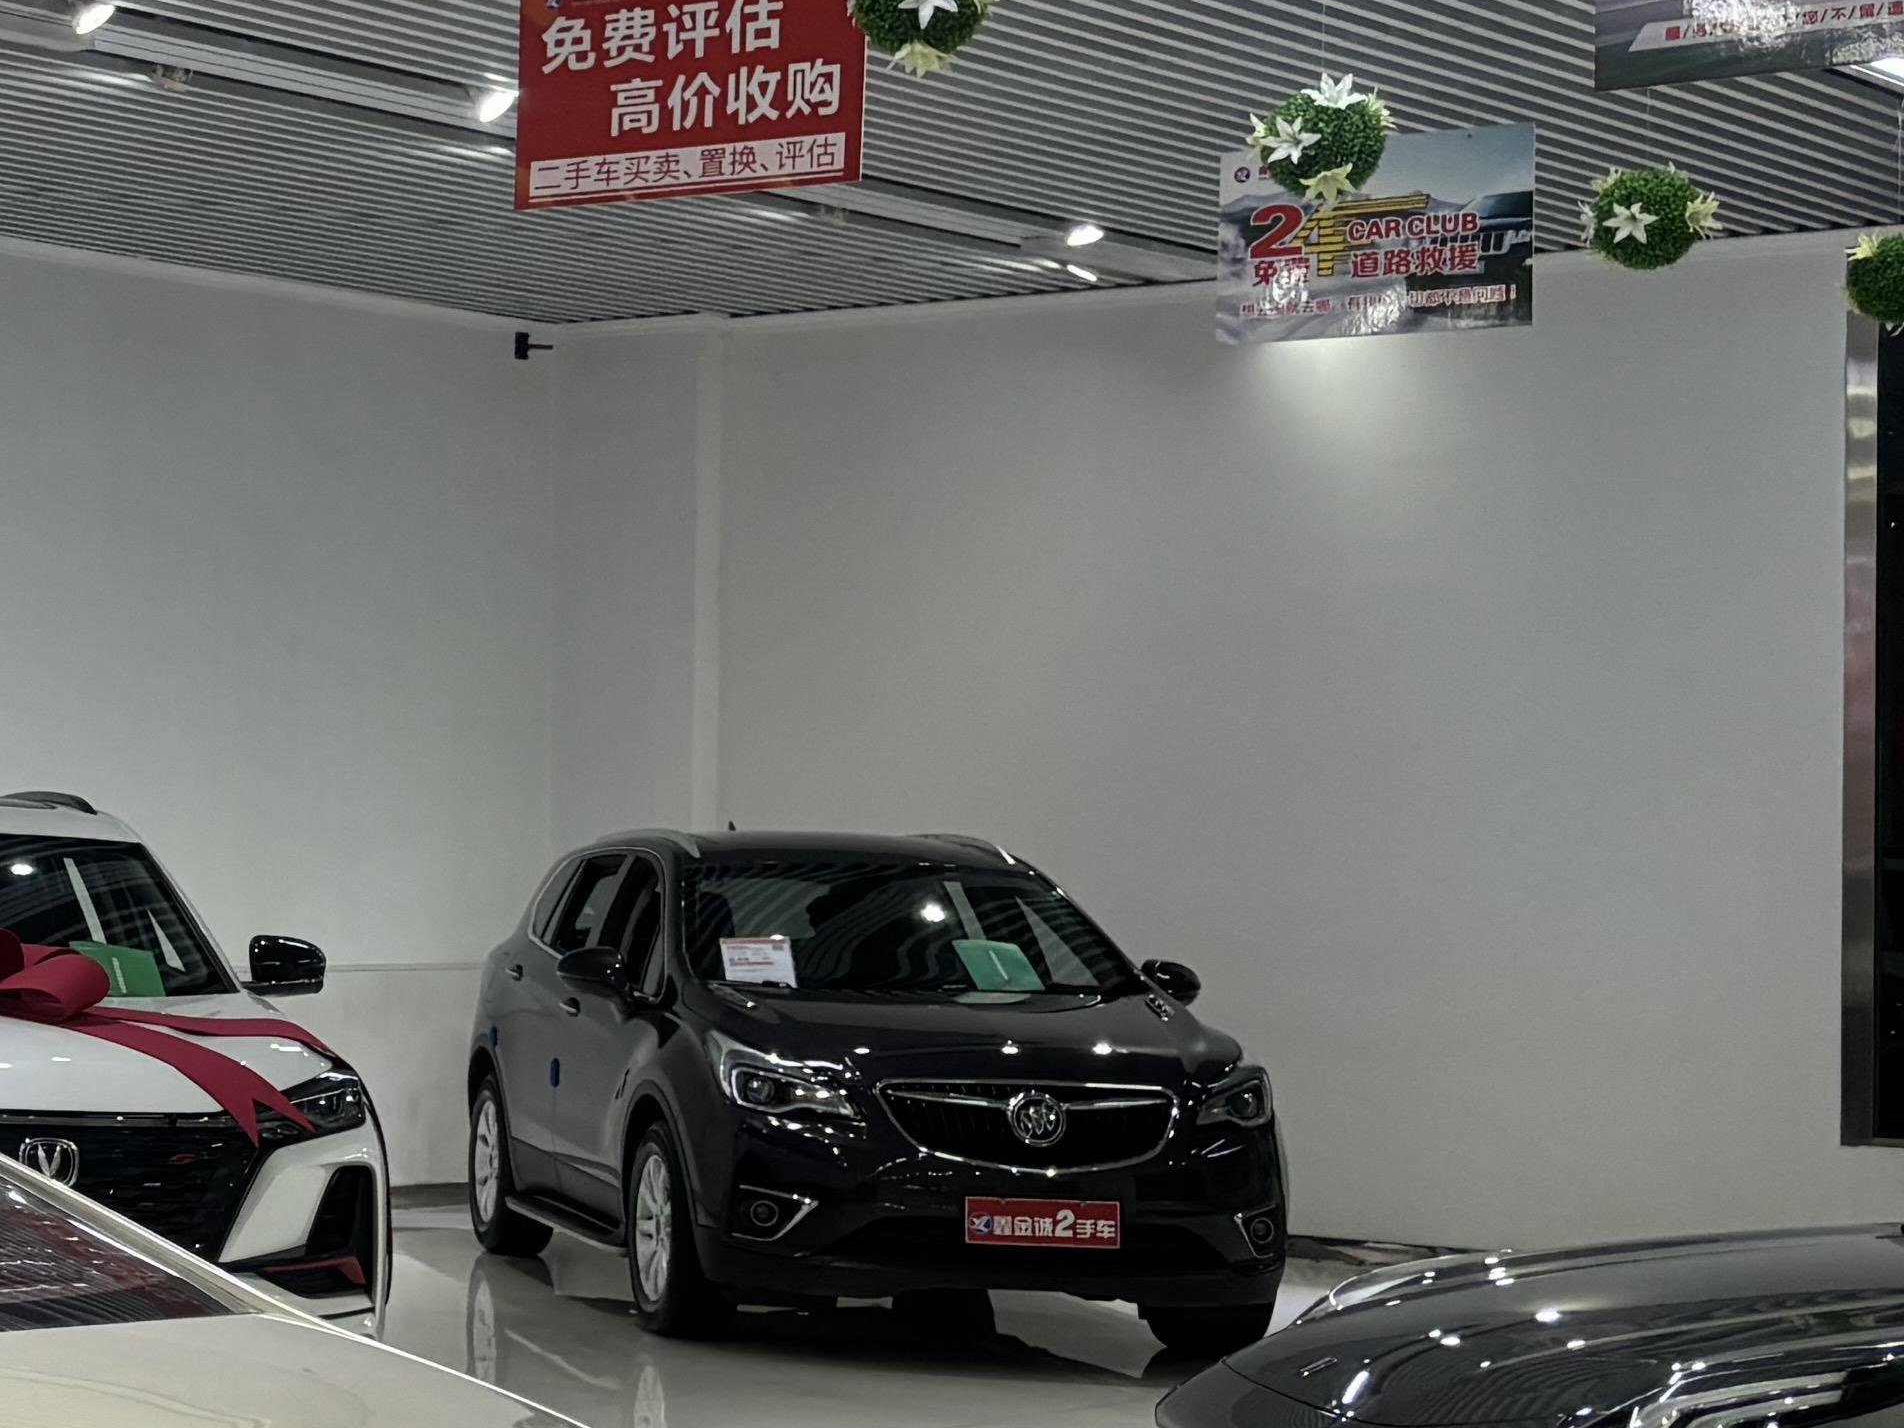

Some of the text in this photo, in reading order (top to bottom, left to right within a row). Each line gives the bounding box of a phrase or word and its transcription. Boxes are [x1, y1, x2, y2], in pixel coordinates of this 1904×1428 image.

[609, 57, 842, 138] 高价收购
[534, 135, 838, 193] 二手车买卖、置换、评估
[1347, 212, 1480, 242] CAR CLUB
[1351, 243, 1479, 279] 道路救援
[993, 1209, 1116, 1239] 鑫金诚2手车
